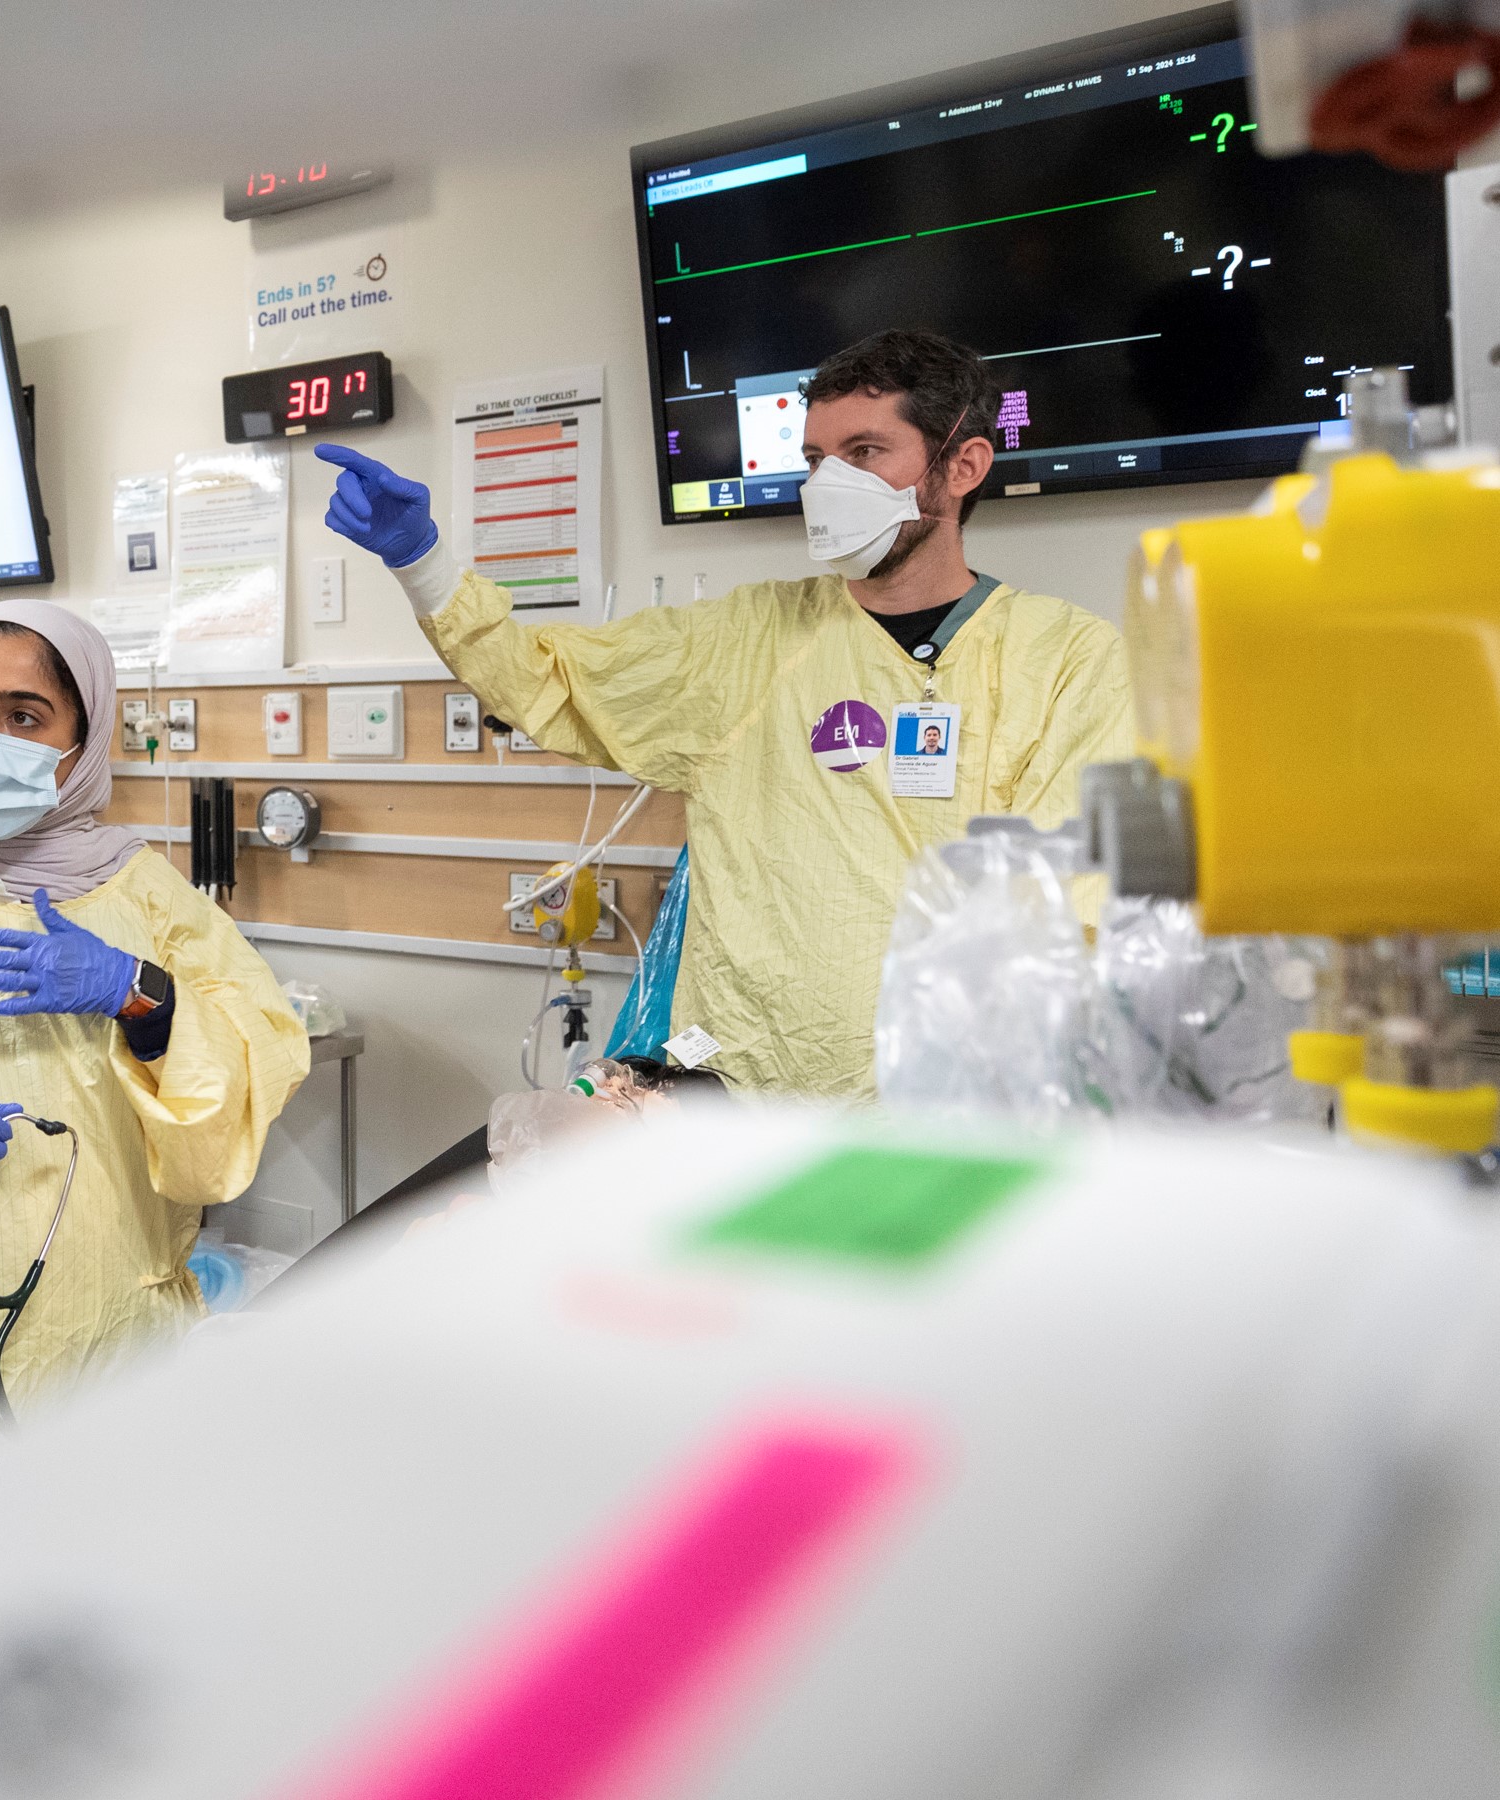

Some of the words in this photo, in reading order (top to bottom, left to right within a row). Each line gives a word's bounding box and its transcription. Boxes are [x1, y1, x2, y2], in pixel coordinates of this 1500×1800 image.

[1126, 67, 1137, 77] 19
[1138, 65, 1153, 75] Sep
[1155, 59, 1174, 71] 2024
[1175, 54, 1197, 66] 15:16
[1032, 83, 1066, 98] DYNAMIC
[1067, 82, 1074, 90] 6
[1075, 75, 1103, 88] WAVES
[1159, 93, 1172, 103] HR
[948, 102, 982, 117] Adolescent
[662, 187, 680, 198] Resp
[680, 182, 702, 194] Leads
[1163, 231, 1175, 241] RR
[257, 287, 293, 306] Ends
[298, 281, 312, 298] in
[316, 274, 336, 293] 5?
[257, 307, 287, 327] Call
[291, 303, 315, 321] out
[320, 297, 346, 315] the
[350, 289, 393, 308] time.
[1304, 356, 1325, 364] Case
[287, 377, 331, 419] 30
[344, 370, 367, 395] 17
[475, 403, 488, 413] RSI
[490, 399, 511, 411] TIME
[513, 395, 531, 408] OUT
[533, 389, 578, 405] CHECKLIST
[1305, 388, 1327, 398] Clock
[809, 525, 829, 537] 3M
[834, 725, 860, 742] EM
